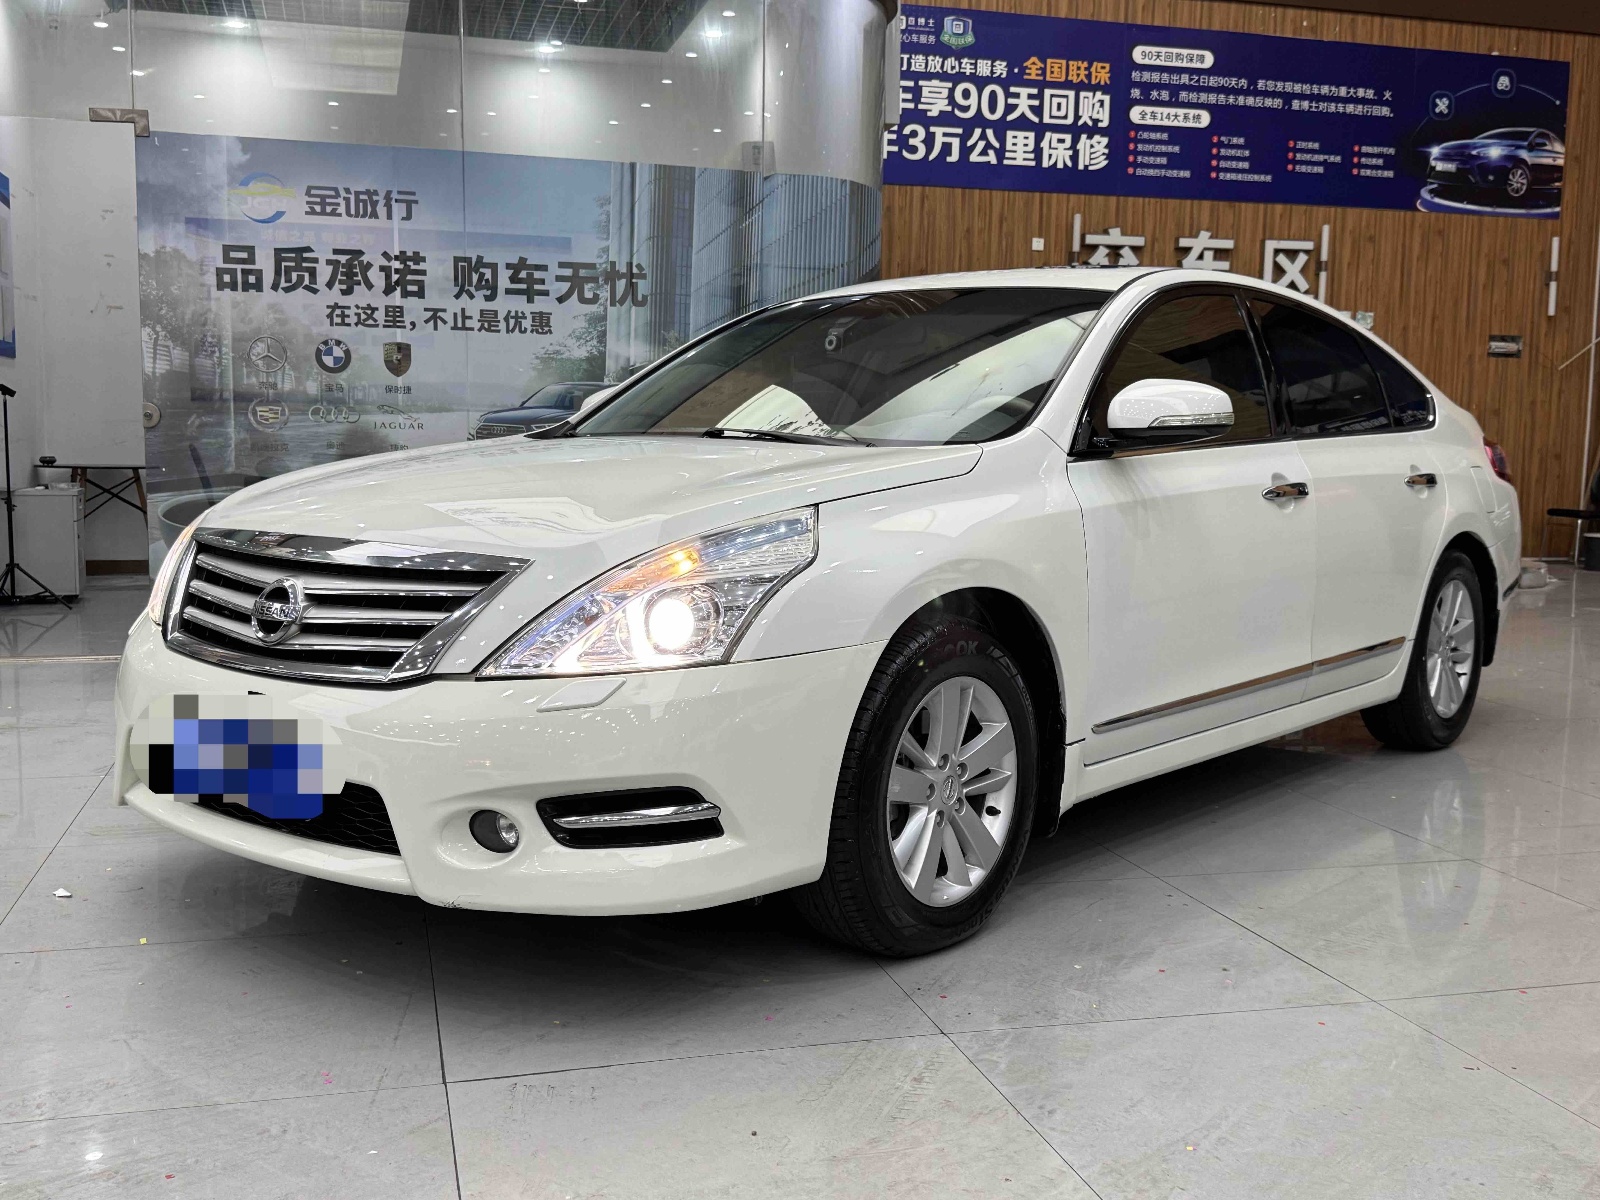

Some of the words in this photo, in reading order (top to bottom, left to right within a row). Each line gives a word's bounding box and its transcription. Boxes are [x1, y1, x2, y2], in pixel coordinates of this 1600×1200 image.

[1140, 50, 1206, 65] 90天回购保障
[1138, 109, 1202, 125] 全车14大系统
[304, 184, 419, 221] 金诚行
[215, 243, 428, 300] 品质承诺
[453, 253, 648, 307] 购车无忧
[318, 339, 348, 351] BMW
[324, 383, 345, 393] 宝马
[384, 385, 412, 395] 保时捷
[374, 421, 424, 431] JAGUAR
